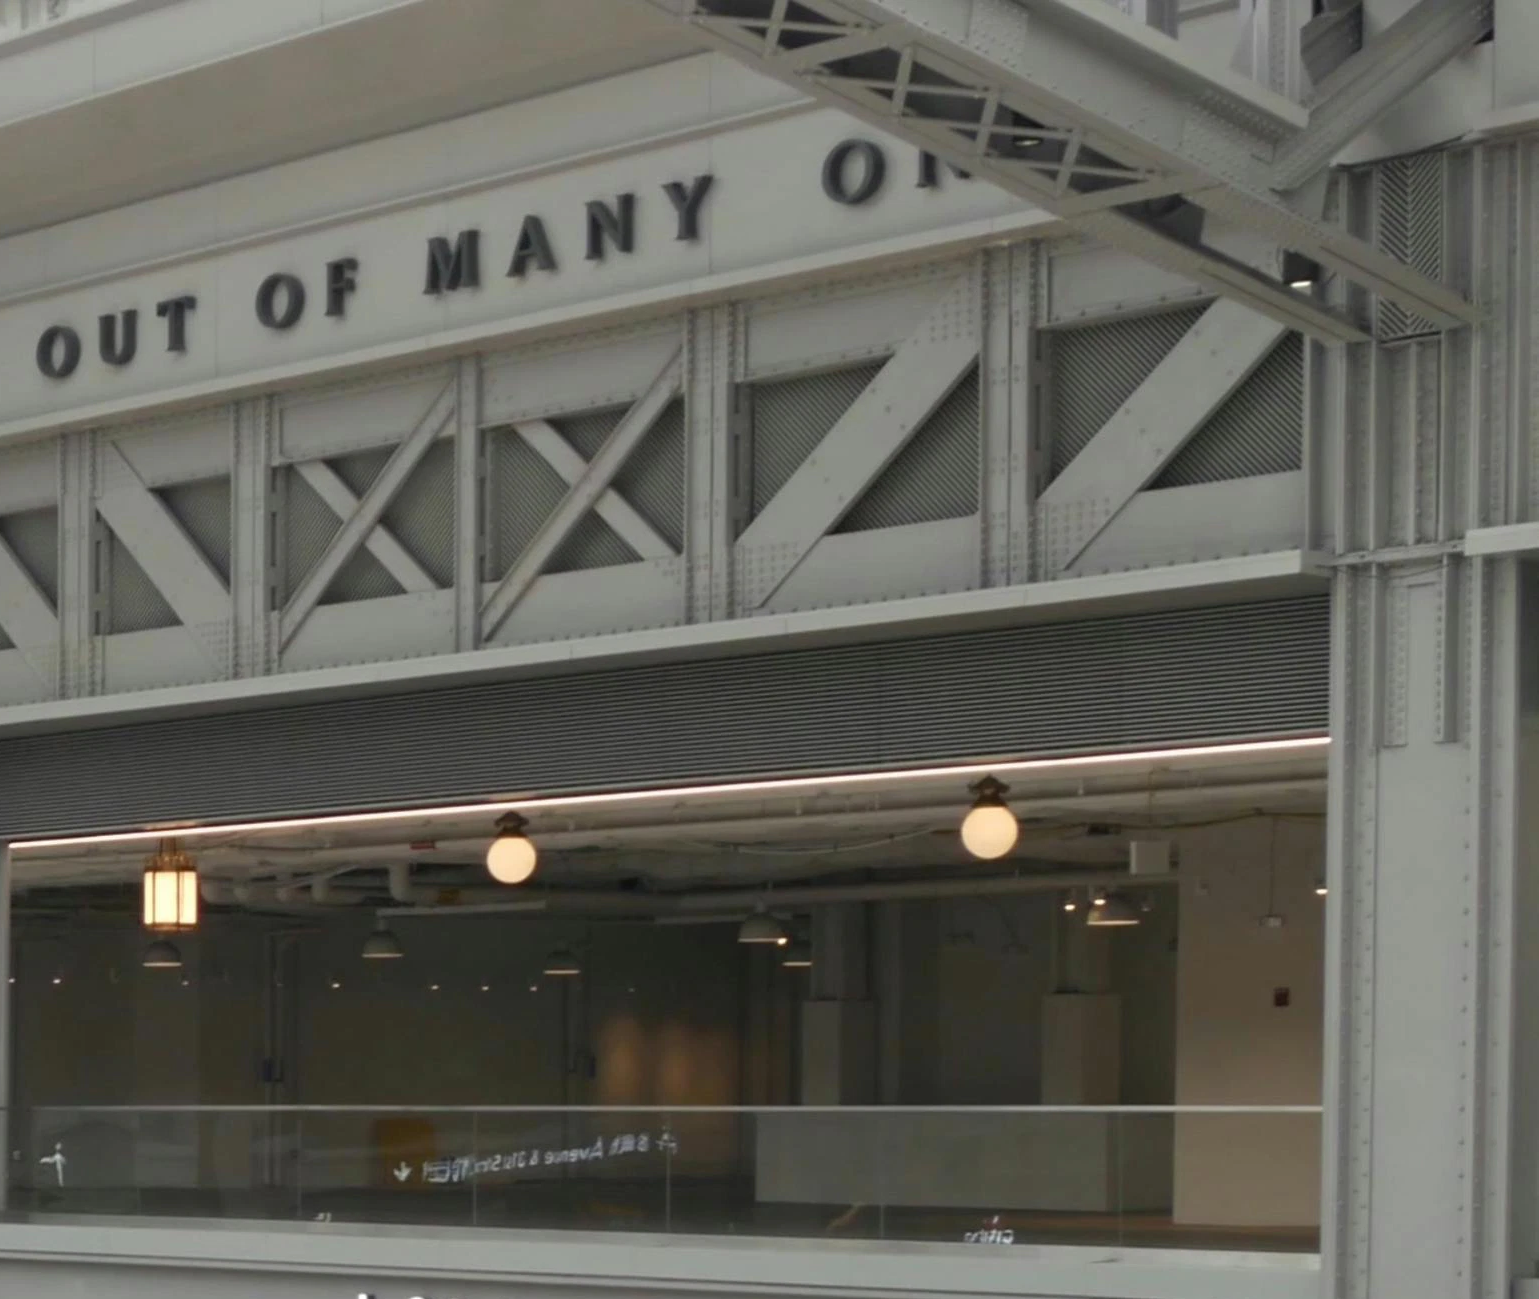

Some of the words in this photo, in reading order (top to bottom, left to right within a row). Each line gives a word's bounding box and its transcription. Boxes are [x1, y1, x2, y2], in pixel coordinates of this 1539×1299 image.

[36, 295, 196, 379] OUT
[255, 257, 359, 330] OF
[423, 175, 714, 294] MANY
